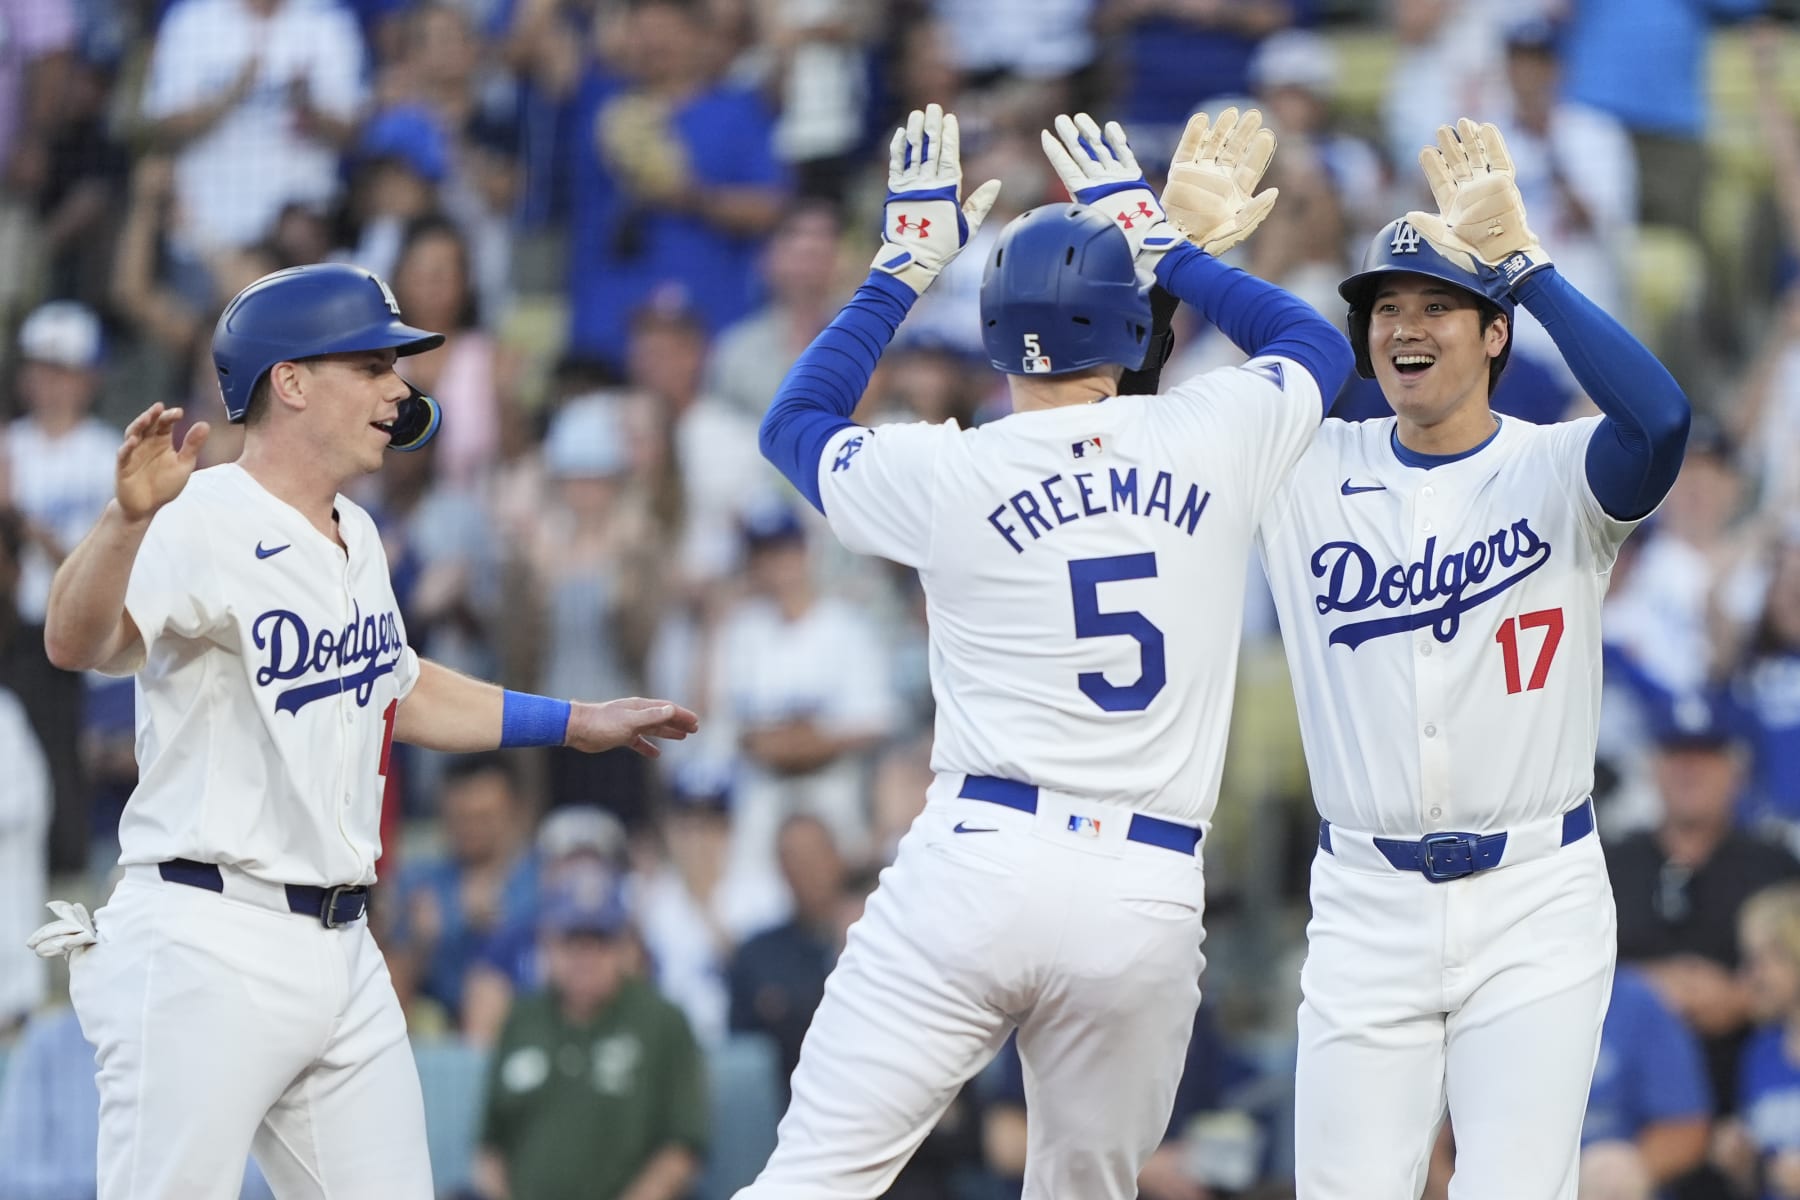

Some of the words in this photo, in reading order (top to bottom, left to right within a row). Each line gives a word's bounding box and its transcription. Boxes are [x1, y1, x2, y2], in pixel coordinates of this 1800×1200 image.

[1023, 333, 1041, 357] 5
[987, 466, 1212, 554] FREEMAN
[1311, 517, 1551, 652] Dodgers
[1067, 551, 1167, 712] 5
[1495, 607, 1565, 695] 17
